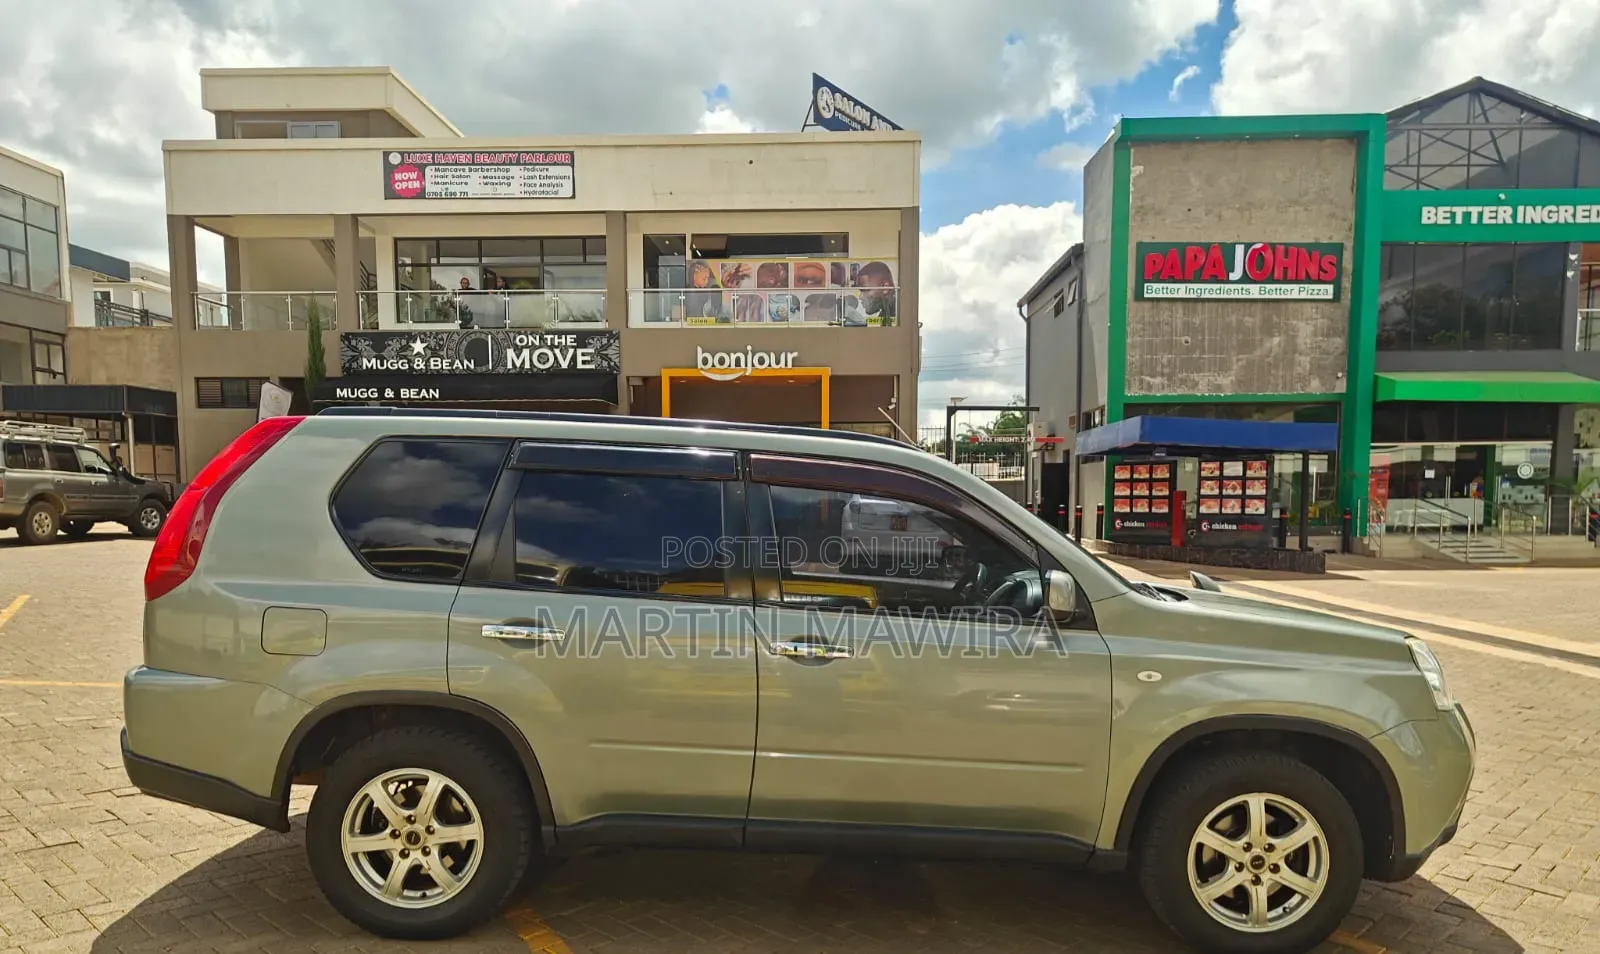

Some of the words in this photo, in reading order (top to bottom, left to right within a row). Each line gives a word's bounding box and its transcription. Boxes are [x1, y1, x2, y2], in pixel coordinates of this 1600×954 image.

[834, 92, 871, 127] SALON
[434, 152, 473, 164] HAVEN
[475, 152, 518, 164] BEAUTY
[520, 152, 571, 164] PARLOUR
[394, 171, 418, 181] NOW
[394, 180, 420, 190] OPEN
[1421, 206, 1514, 225] BETTER
[1516, 205, 1600, 224] INGRED
[1143, 243, 1227, 281] PAPA
[1229, 243, 1338, 282] JOHNS
[1145, 284, 1181, 296] Better
[1184, 285, 1254, 298] Ingredients.
[1258, 285, 1294, 297] Better
[1298, 286, 1329, 297] Pizza
[515, 334, 543, 347] ON
[545, 334, 577, 347] THE
[362, 357, 409, 370] MUGG
[413, 357, 427, 370] &
[430, 357, 475, 370] BEAN
[506, 347, 596, 370] MOVE
[697, 344, 799, 377] bonjour
[336, 387, 379, 399] MUGG
[384, 387, 395, 398] &
[400, 387, 440, 399] BEAN
